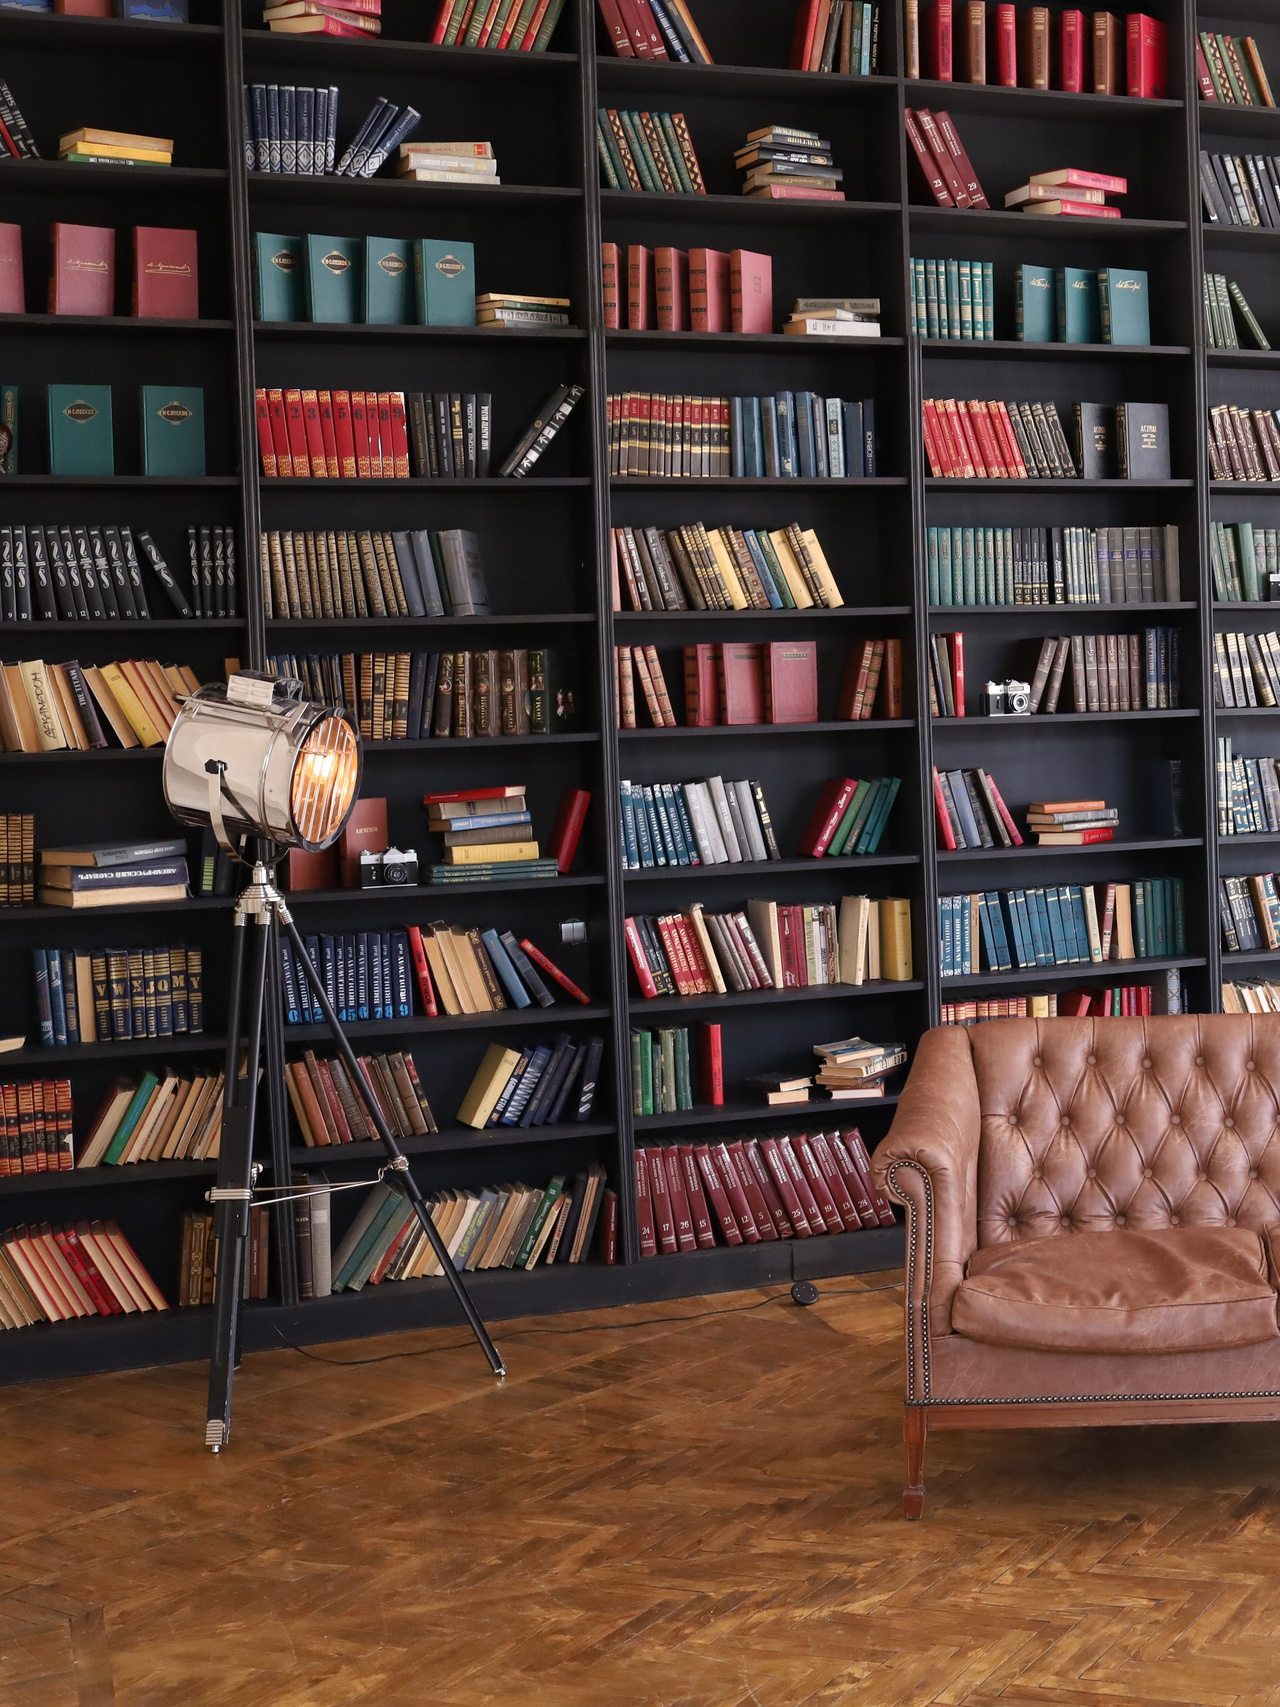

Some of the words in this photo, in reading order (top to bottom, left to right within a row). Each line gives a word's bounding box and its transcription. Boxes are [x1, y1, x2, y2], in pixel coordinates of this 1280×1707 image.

[615, 26, 622, 34] 2
[635, 29, 641, 37] 4
[651, 34, 657, 42] 6
[1202, 76, 1210, 85] 22
[933, 179, 942, 188] 23
[953, 180, 958, 188] 1
[968, 182, 977, 191] 29
[290, 407, 300, 420] 2
[307, 407, 317, 420] 3
[321, 407, 331, 420] 4
[338, 407, 347, 421] 5
[353, 408, 363, 421] 6
[368, 408, 377, 420] 7
[380, 409, 390, 421] 8
[392, 407, 402, 420] 9
[69, 669, 82, 693] TITAN
[31, 672, 57, 739] ДЕКАМЕРОН
[77, 693, 87, 708] THE
[78, 872, 115, 880] СЛОВАРЬ
[115, 868, 177, 879] АНГЛО-РУССКИЙ
[532, 950, 554, 970] СЛОВИН
[172, 975, 185, 988] M
[190, 976, 200, 989] Y
[283, 962, 296, 1008] BRIDLEWAY
[398, 956, 406, 1003] BRIDLEWAY
[96, 984, 106, 997] V
[112, 983, 125, 995] W
[131, 980, 142, 993] X
[146, 981, 155, 994] J
[157, 980, 169, 992] Q
[288, 1010, 299, 1022] 0
[313, 1008, 323, 1020] 2
[338, 1009, 346, 1021] 4
[347, 1009, 356, 1021] 5
[358, 1006, 368, 1019] 6
[374, 1007, 382, 1019] 7
[384, 1006, 393, 1019] 8
[399, 1005, 409, 1017] 9
[792, 1209, 801, 1218] 25
[824, 1204, 832, 1212] 19
[723, 1216, 732, 1224] 21
[758, 1212, 764, 1220] 5
[663, 1223, 670, 1231] 17
